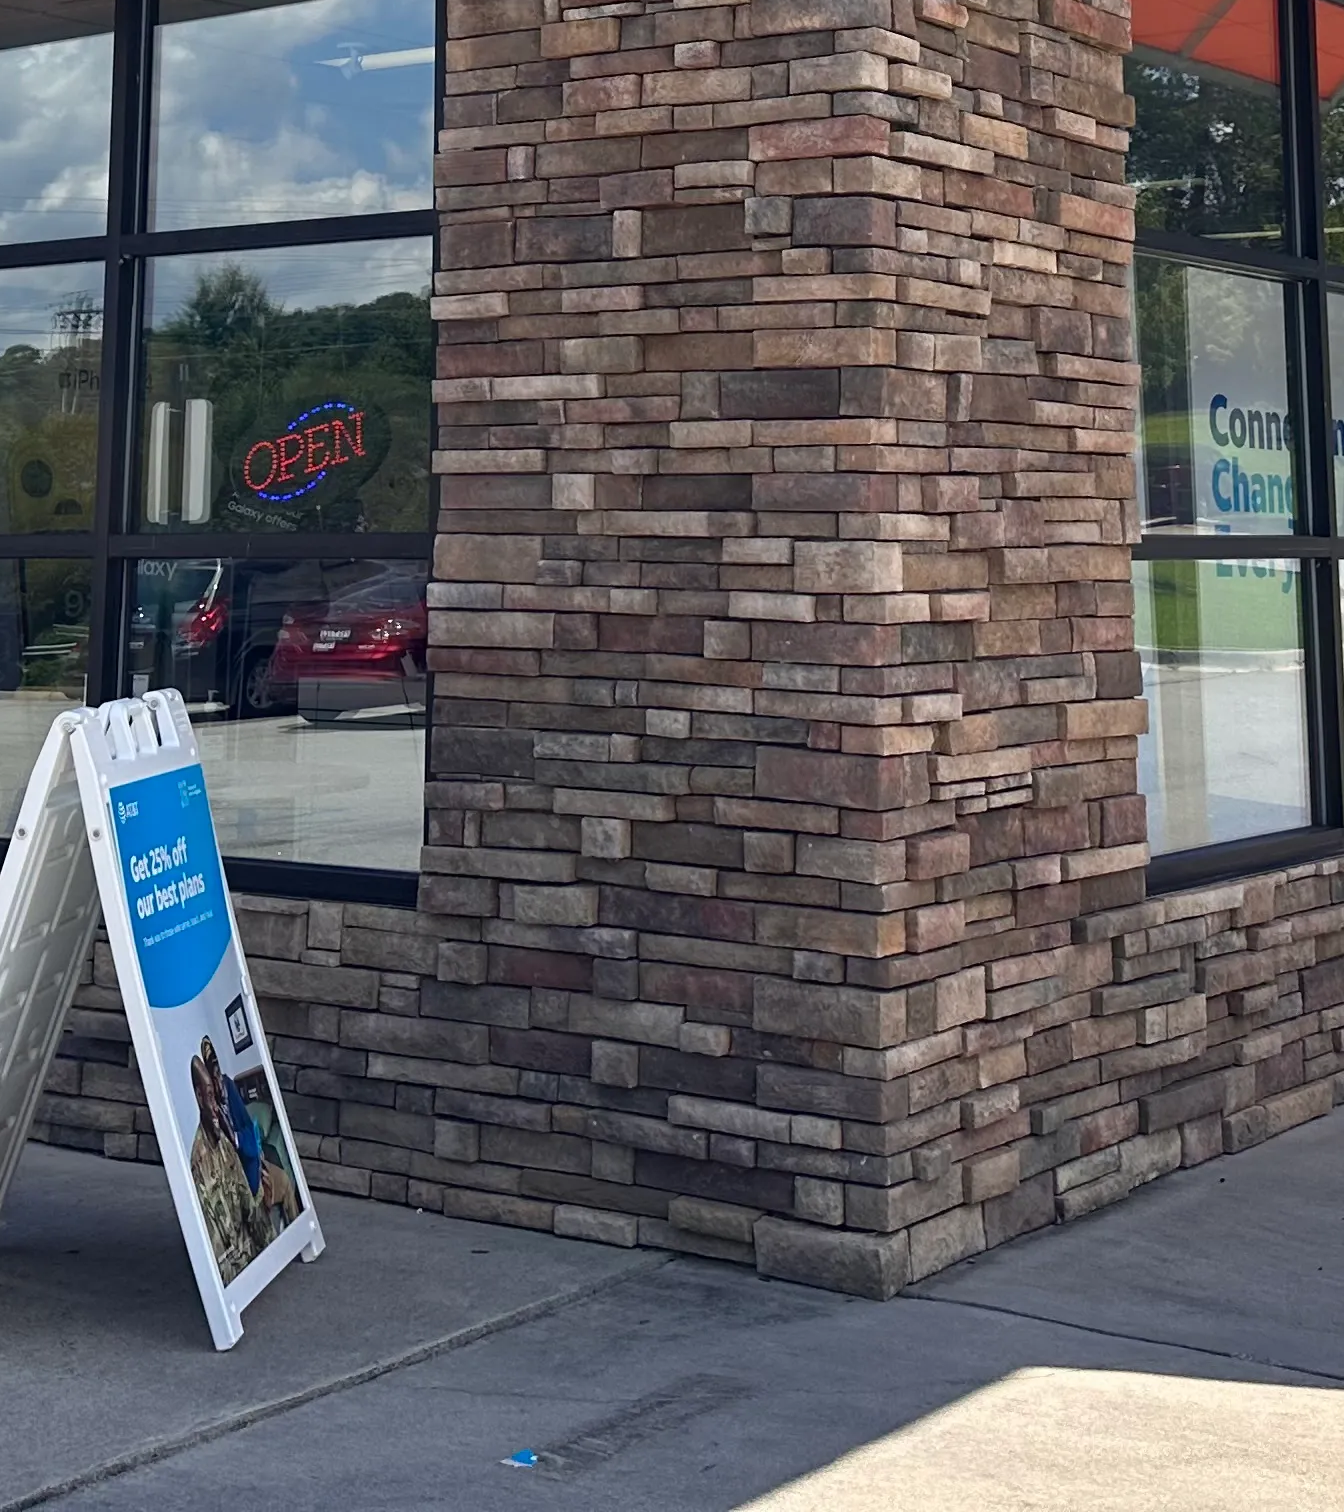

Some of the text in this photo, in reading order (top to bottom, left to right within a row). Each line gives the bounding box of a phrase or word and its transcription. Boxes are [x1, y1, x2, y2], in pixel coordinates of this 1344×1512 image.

[243, 411, 366, 493] OPEN
[227, 500, 299, 532] Galaxy offers
[130, 835, 188, 884] Get 25% off
[137, 872, 205, 921] our best plans
